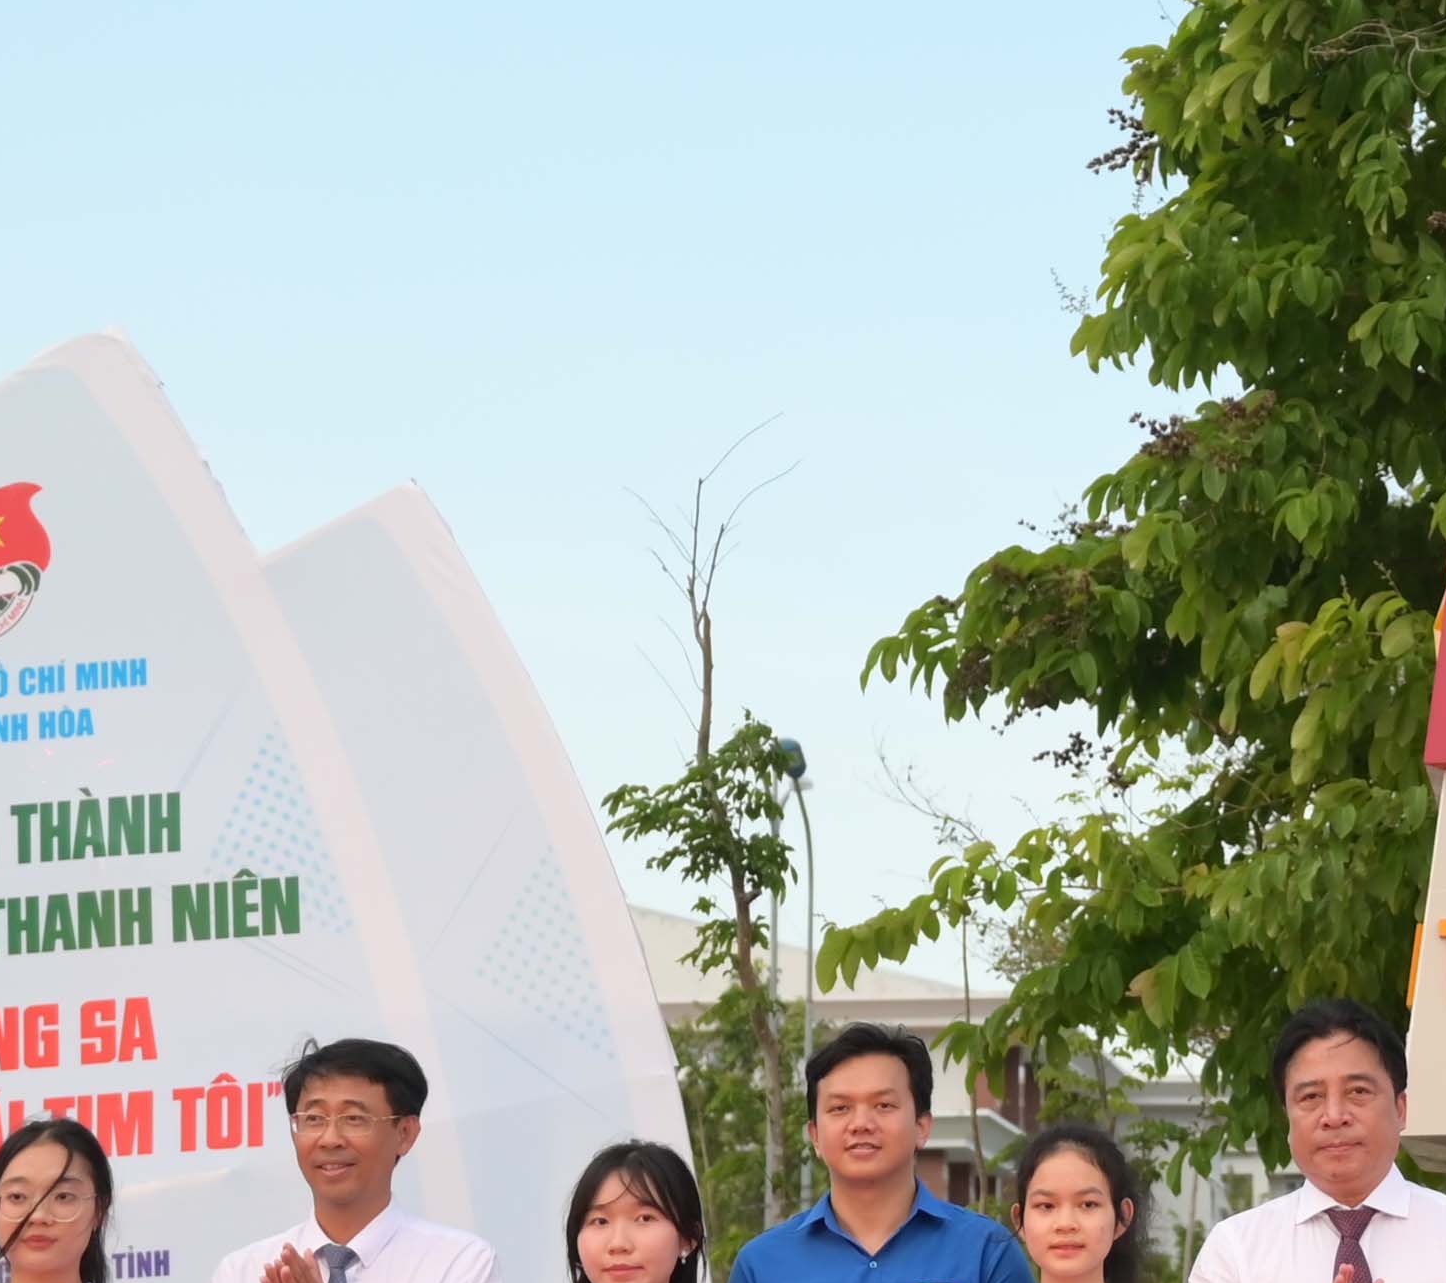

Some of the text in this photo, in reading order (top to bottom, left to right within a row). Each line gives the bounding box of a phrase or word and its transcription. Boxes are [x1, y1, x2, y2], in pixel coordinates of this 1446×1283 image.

[18, 660, 66, 696] CHÍ
[76, 657, 148, 690] MINH
[10, 787, 181, 864] THÀNH
[171, 868, 301, 943] NIÊN
[79, 996, 158, 1065] SA
[112, 1248, 170, 1280] TỈNH
